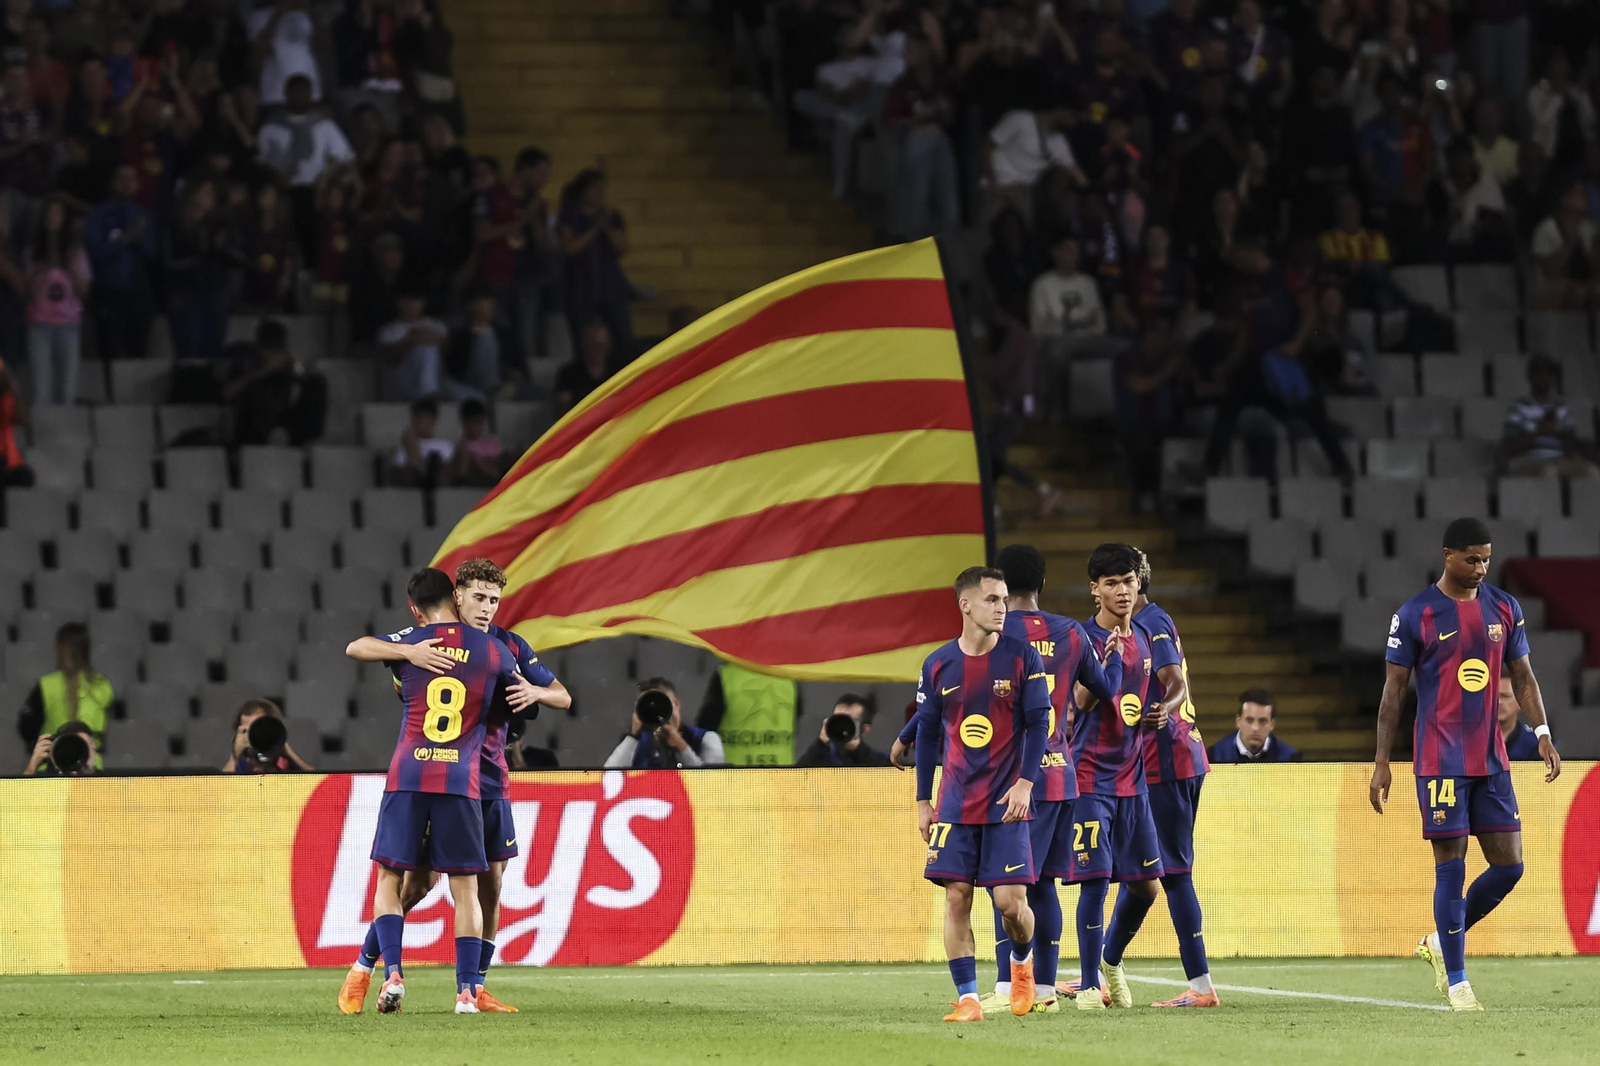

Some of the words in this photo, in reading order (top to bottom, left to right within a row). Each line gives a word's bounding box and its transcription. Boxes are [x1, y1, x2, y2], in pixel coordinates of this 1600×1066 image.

[423, 677, 466, 742] 8
[1427, 778, 1457, 807] 14
[1073, 820, 1100, 852] 27
